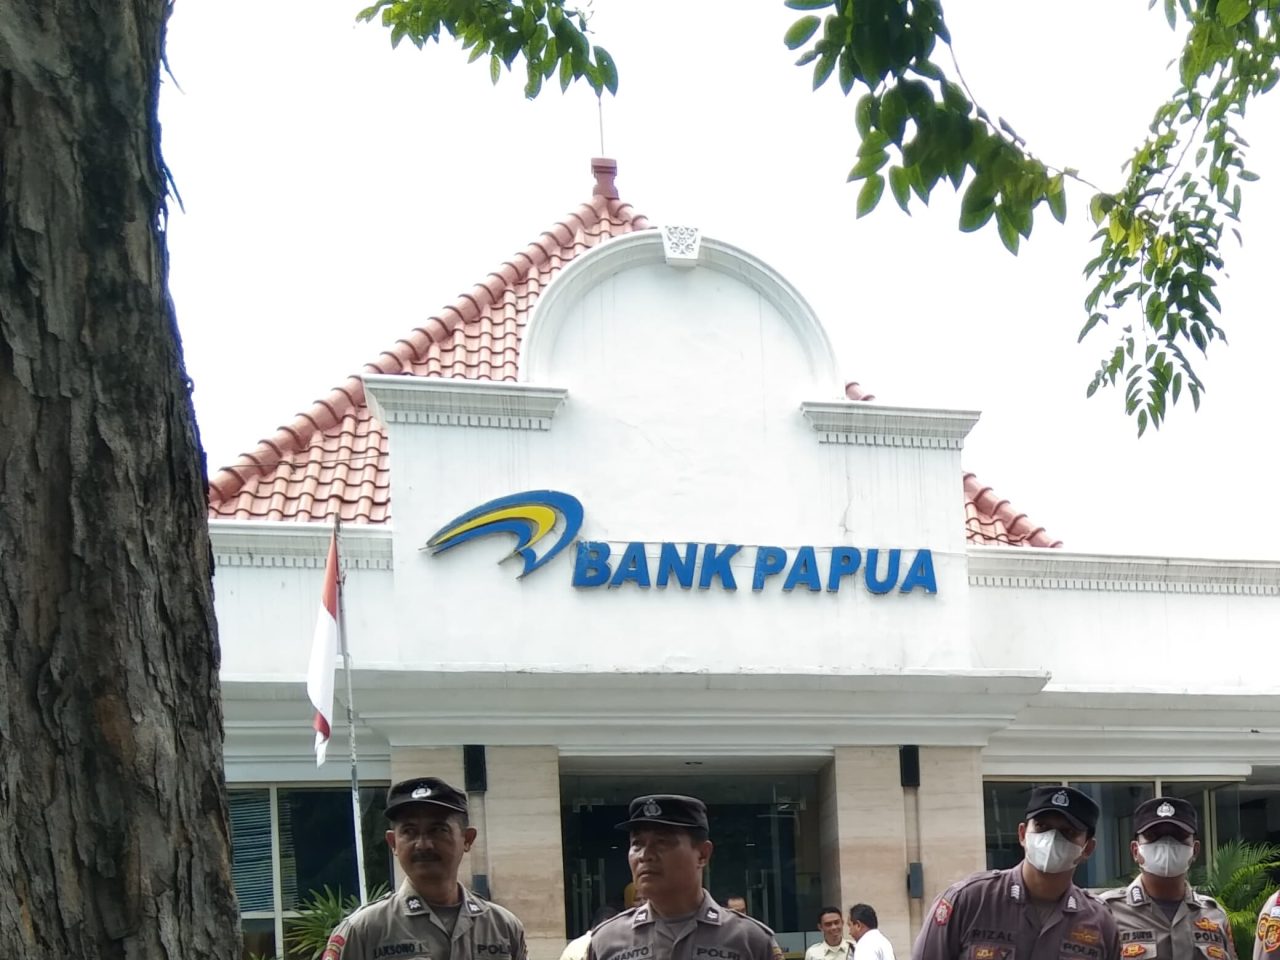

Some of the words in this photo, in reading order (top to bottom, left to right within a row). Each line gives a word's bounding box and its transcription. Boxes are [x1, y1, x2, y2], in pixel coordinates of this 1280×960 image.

[572, 540, 743, 590] BANK
[752, 545, 938, 595] PAPUA
[972, 929, 1013, 942] RIZAL
[1063, 943, 1098, 957] POLRI
